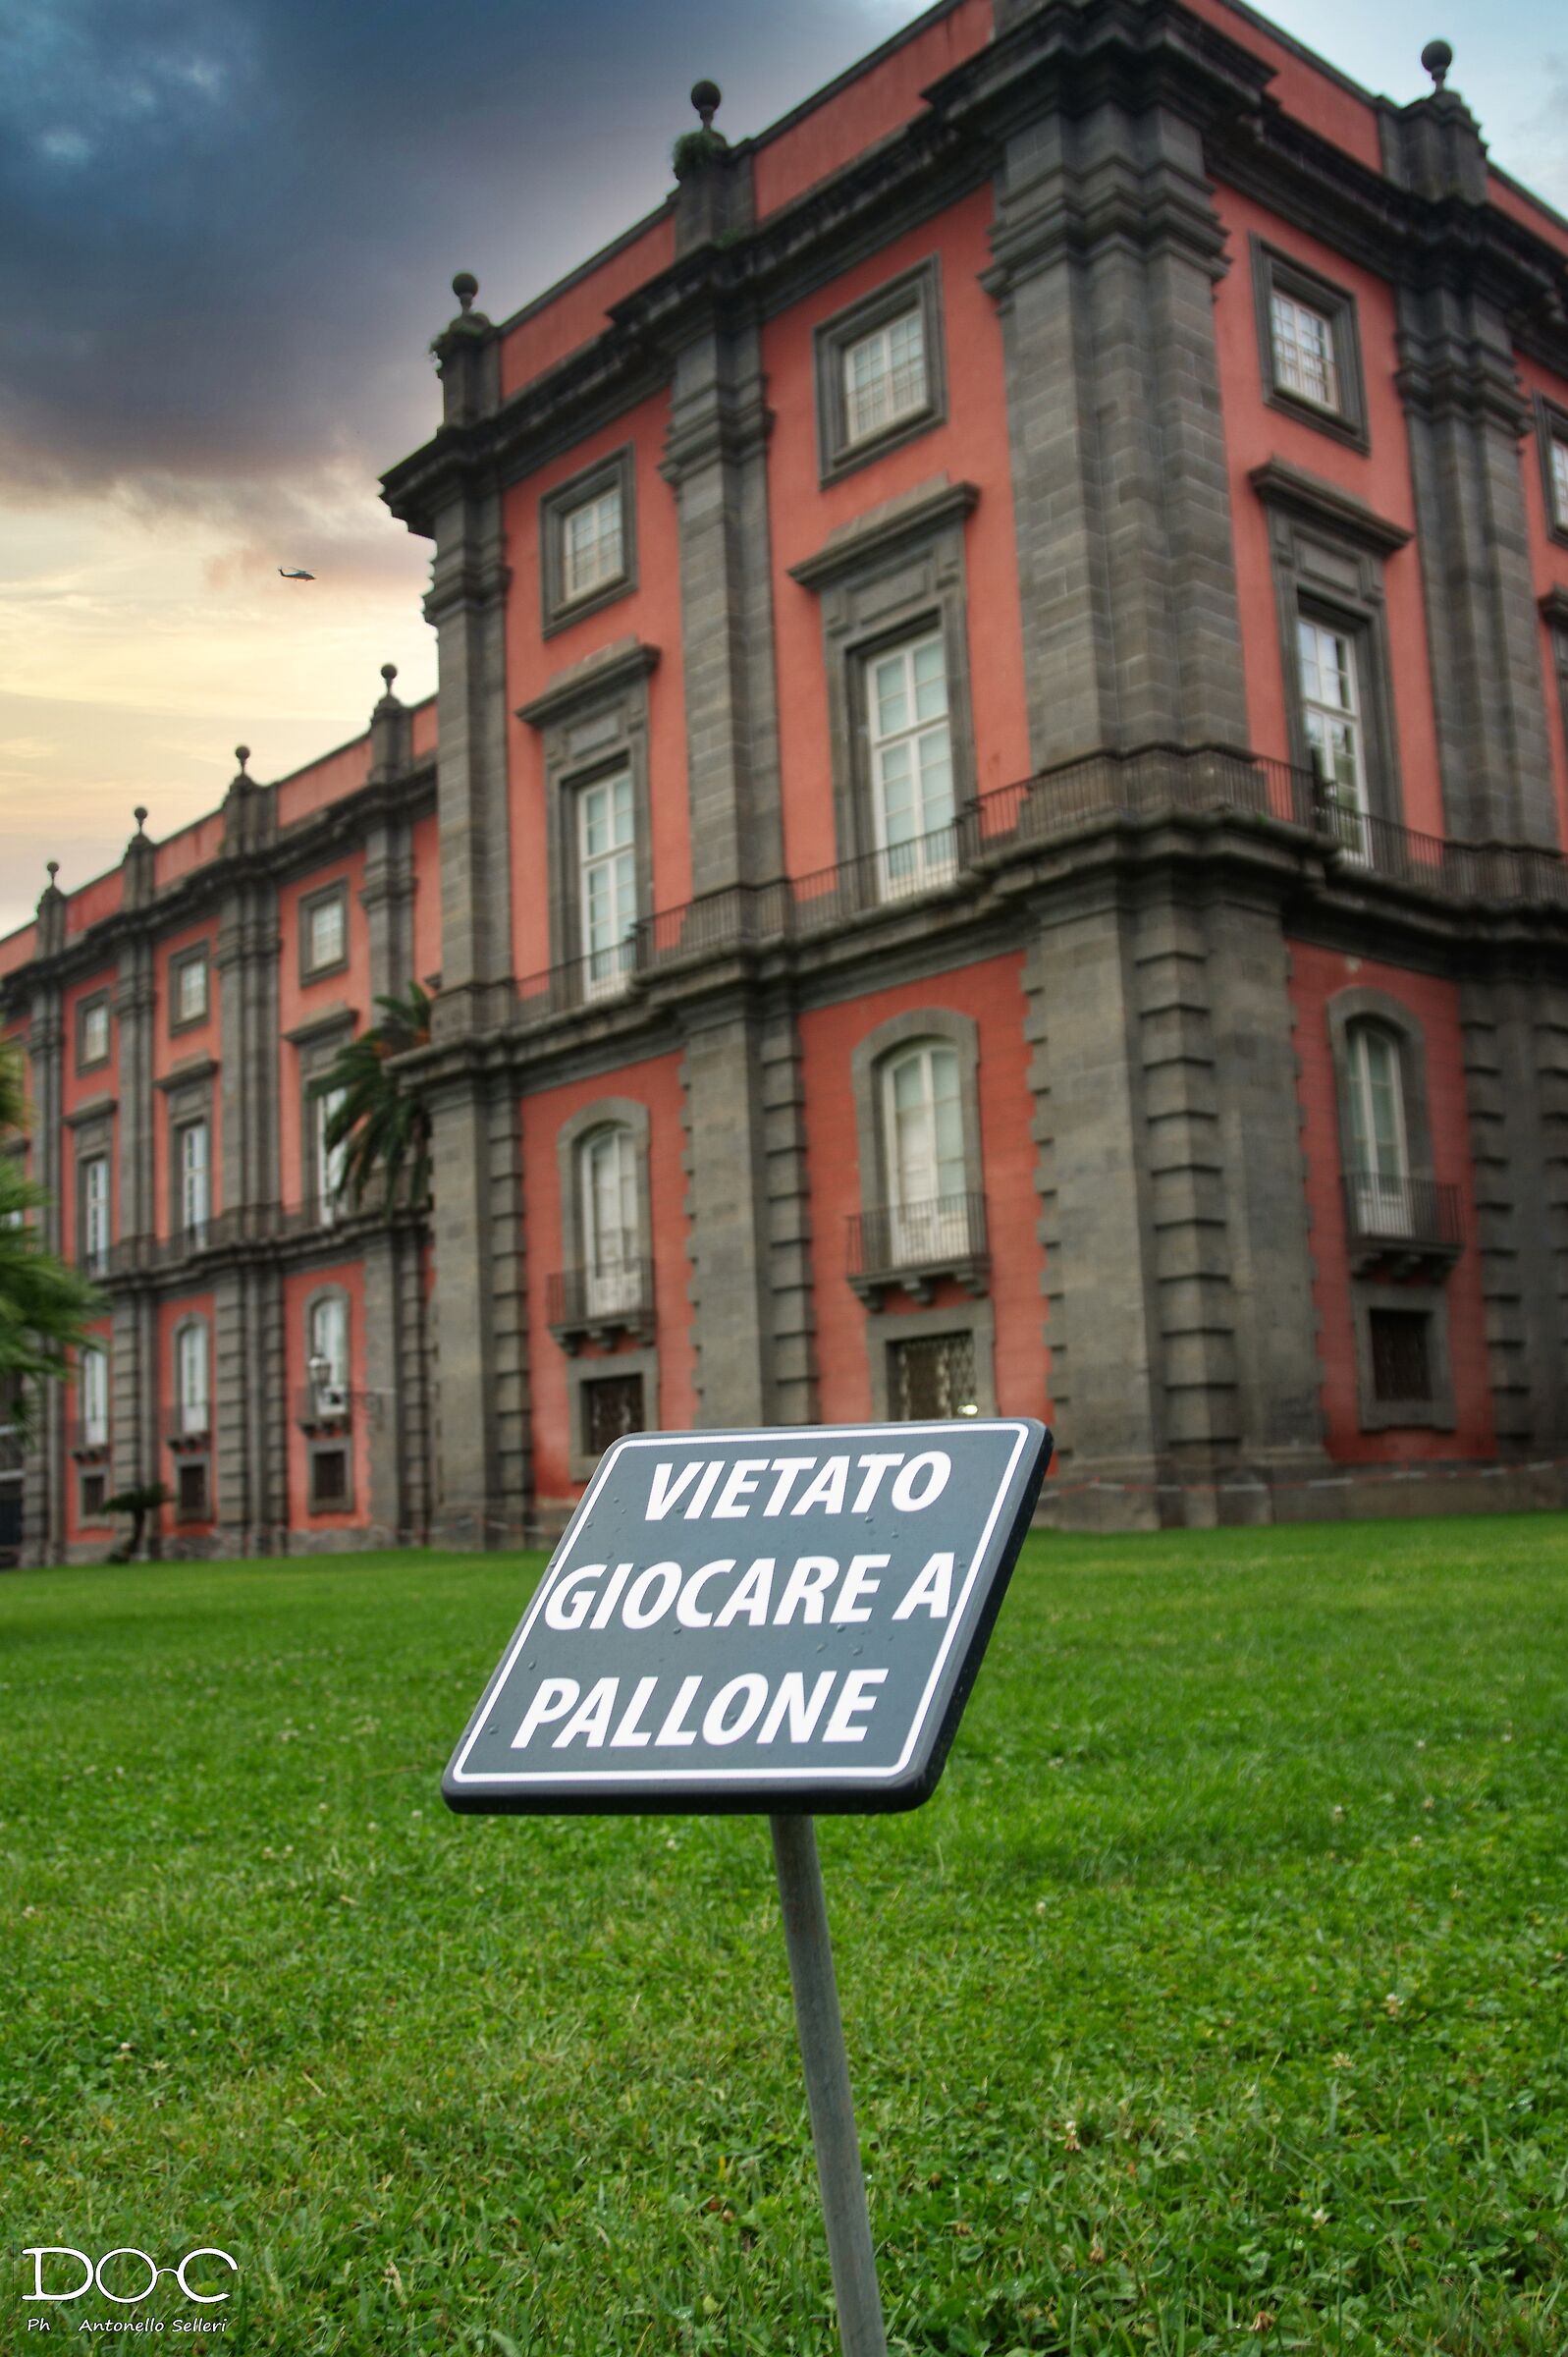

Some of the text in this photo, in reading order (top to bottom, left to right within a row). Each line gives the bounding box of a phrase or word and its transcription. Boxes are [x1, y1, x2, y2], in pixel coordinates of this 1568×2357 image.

[644, 1451, 951, 1521] VIETATO
[544, 1552, 955, 1630] GIOCARE A
[510, 1669, 890, 1749] PALLONE
